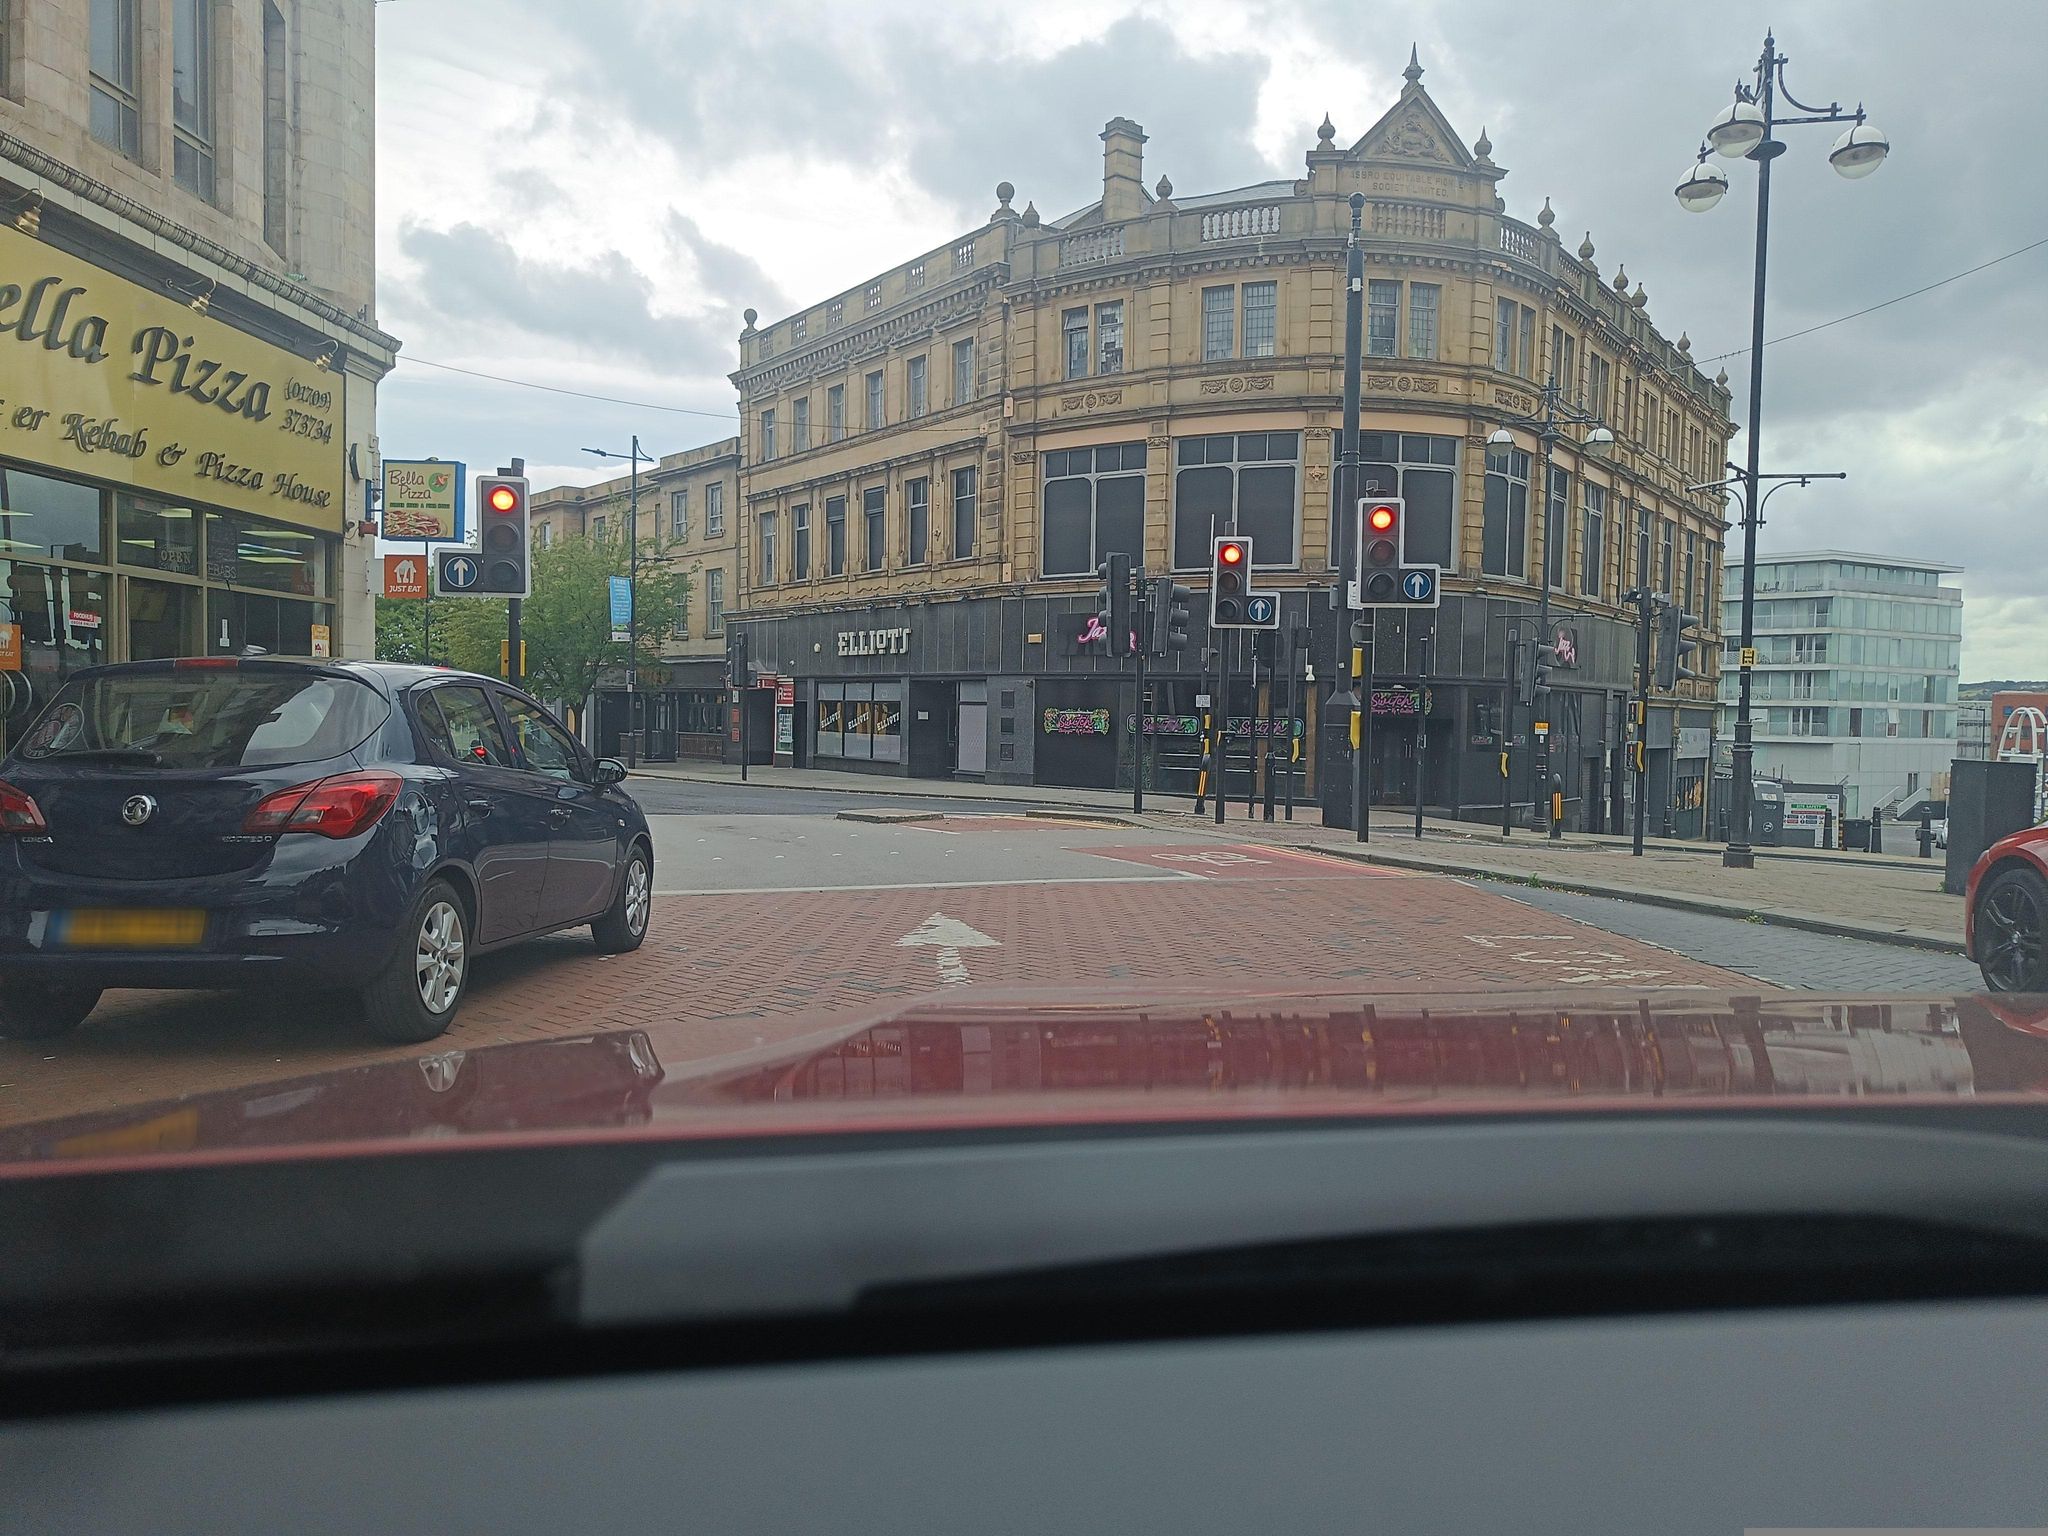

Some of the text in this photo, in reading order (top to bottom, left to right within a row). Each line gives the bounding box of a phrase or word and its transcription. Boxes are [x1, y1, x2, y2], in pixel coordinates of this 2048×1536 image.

[130, 327, 271, 422] Pizza
[285, 376, 332, 413] (01709)
[282, 409, 333, 444] 373734
[62, 413, 148, 458] Kebab
[158, 443, 187, 466] &
[196, 452, 263, 490] Pizza
[272, 473, 331, 508] House
[388, 470, 424, 485] Bella
[399, 484, 431, 499] Pizza
[160, 550, 191, 563] OPEN
[1371, 691, 1414, 706] Switch
[1057, 714, 1094, 729] Switch
